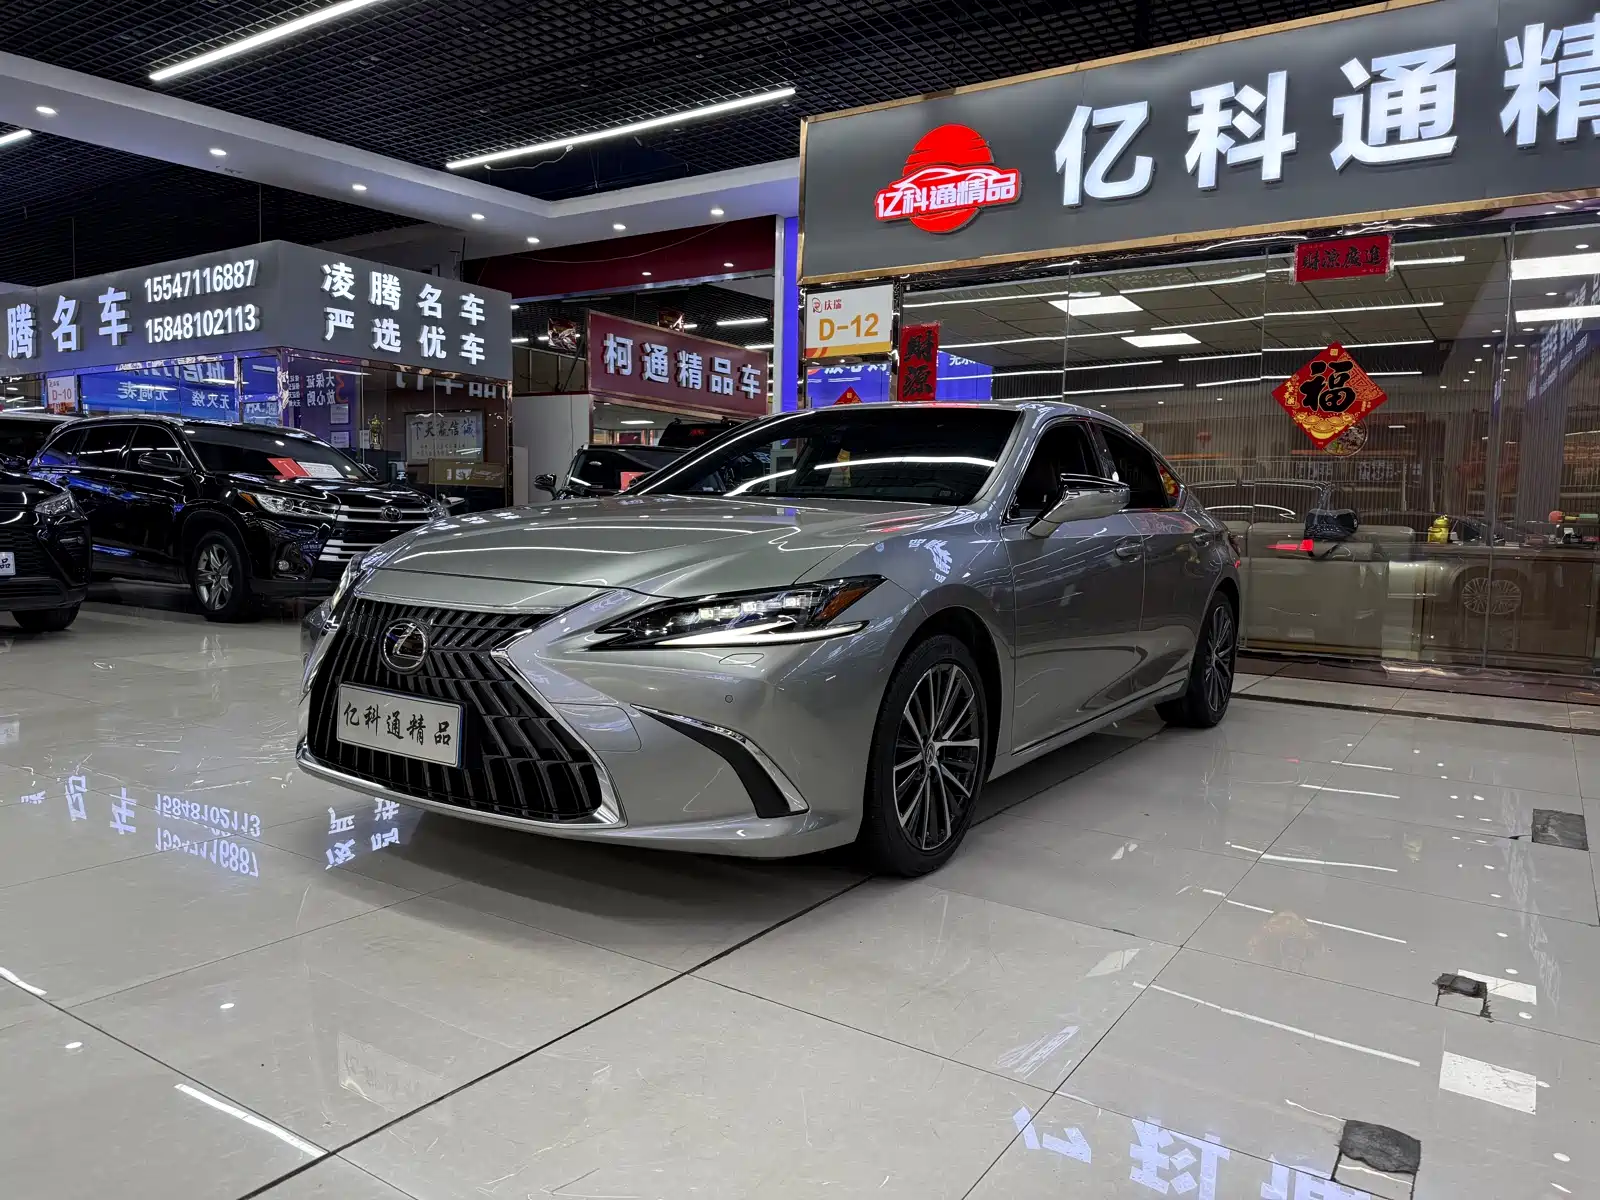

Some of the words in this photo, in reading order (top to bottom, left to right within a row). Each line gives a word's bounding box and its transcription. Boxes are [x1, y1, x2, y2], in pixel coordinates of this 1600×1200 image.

[1055, 13, 1600, 207] 亿科通精
[876, 172, 1017, 218] 亿科通精品
[144, 259, 257, 303] 15547116887
[320, 262, 486, 326] 凌腾名车
[7, 286, 130, 359] 腾名车
[145, 304, 258, 343] 15848102113
[323, 307, 486, 365] 严选优车
[818, 313, 880, 342] D-12
[603, 333, 761, 399] 柯通精品车
[1299, 360, 1357, 413] 福
[51, 388, 72, 401] D-10
[343, 701, 452, 747] 亿科通精品
